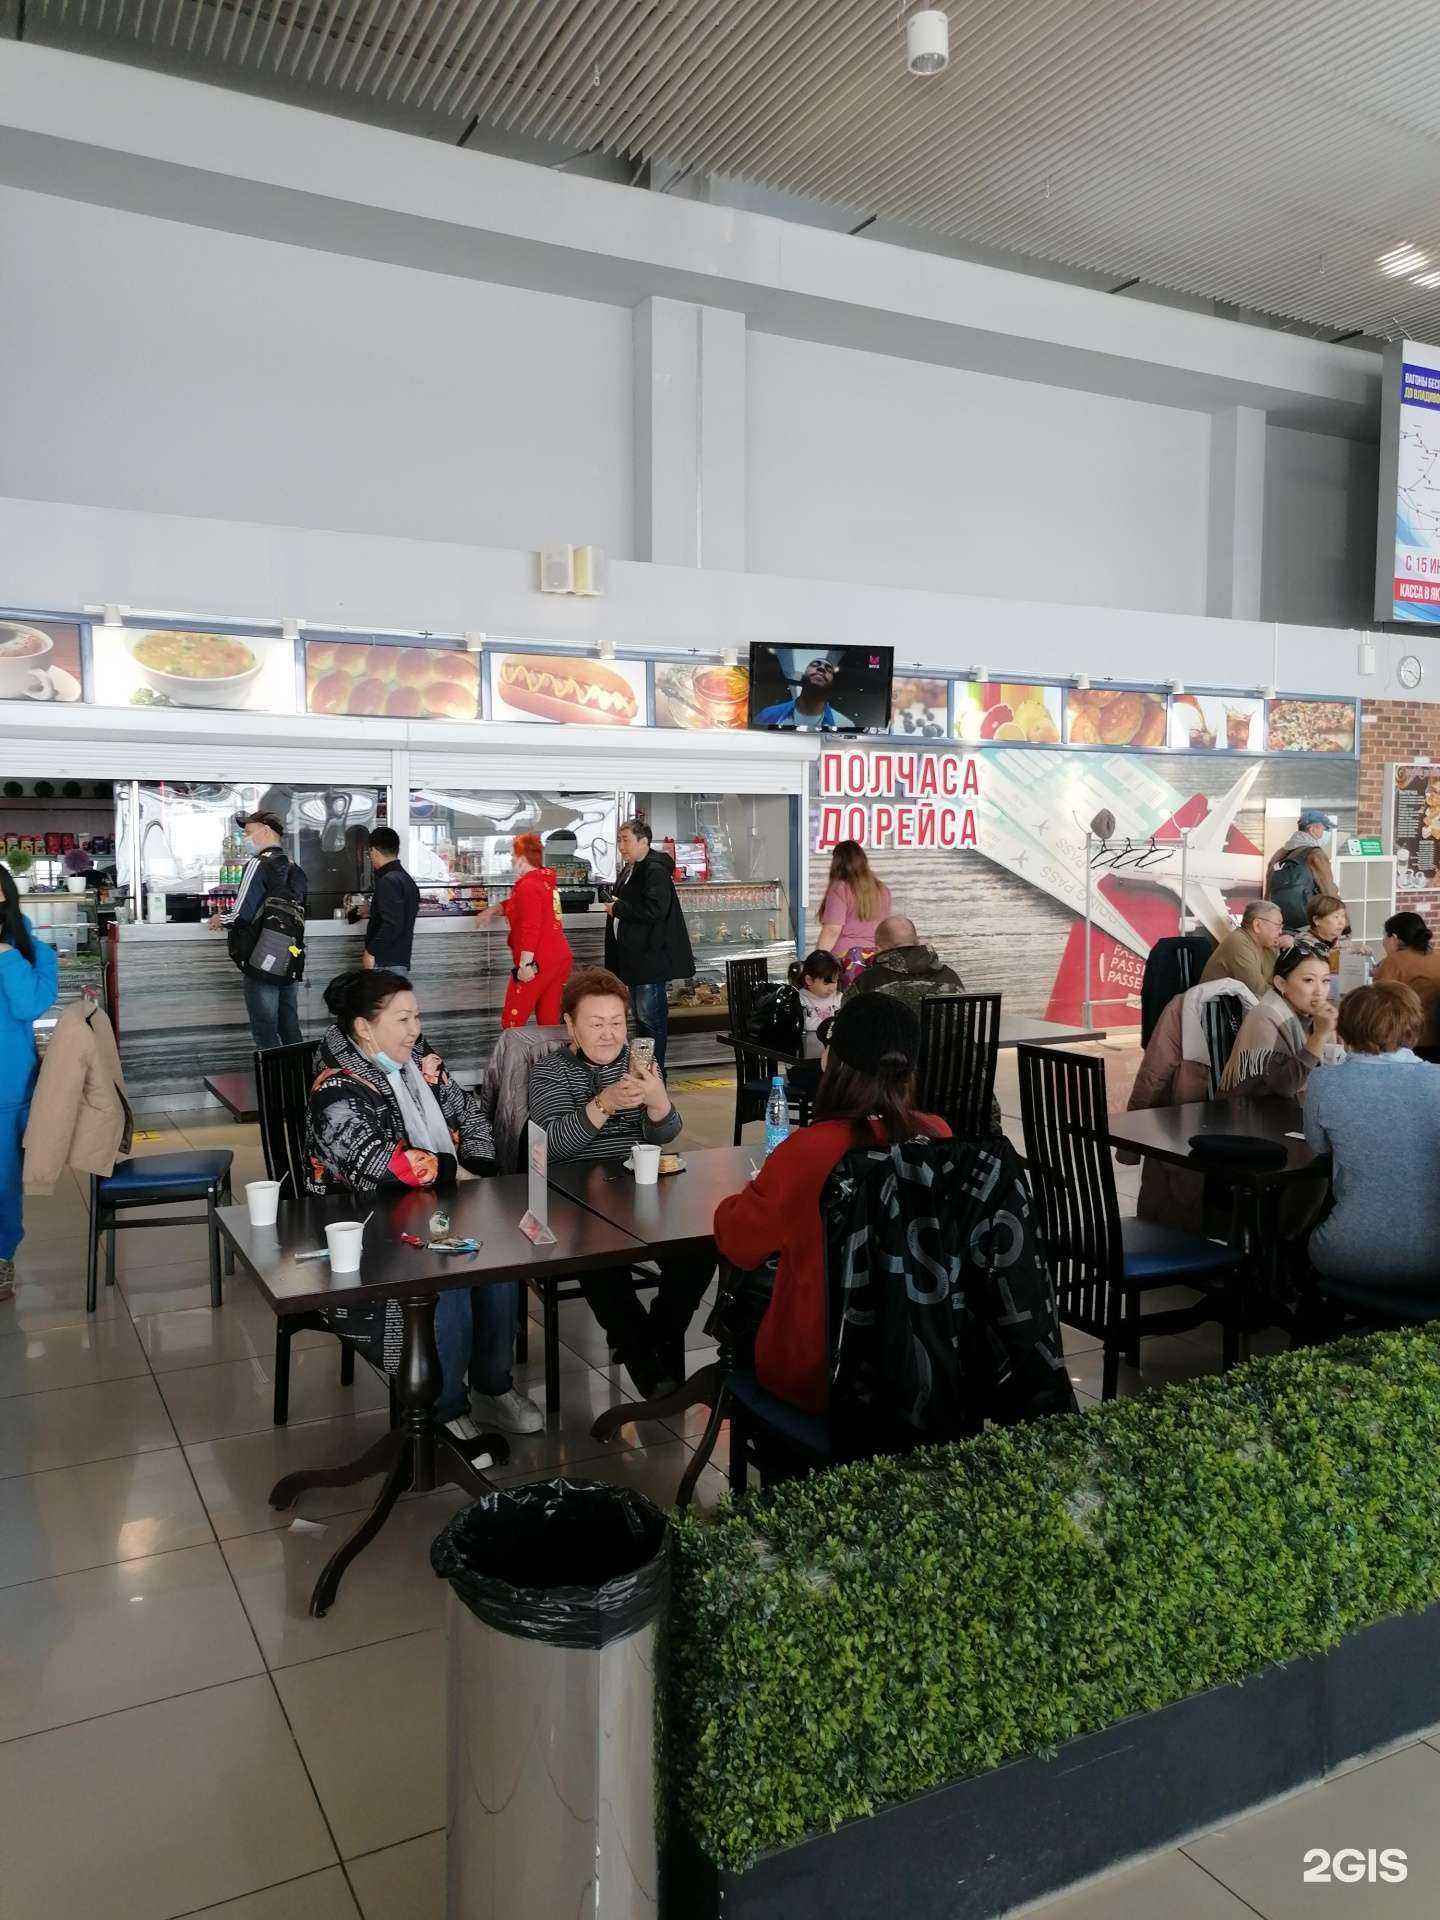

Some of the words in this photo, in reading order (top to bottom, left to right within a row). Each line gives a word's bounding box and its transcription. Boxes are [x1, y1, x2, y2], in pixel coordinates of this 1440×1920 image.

[1405, 555, 1412, 571] С
[1416, 557, 1427, 573] 15
[1400, 583, 1423, 599] КАССА
[1424, 586, 1430, 600] В
[823, 753, 979, 796] ПОЛЧАСА
[818, 806, 865, 850] ДО
[875, 802, 977, 847] РЕЙСА
